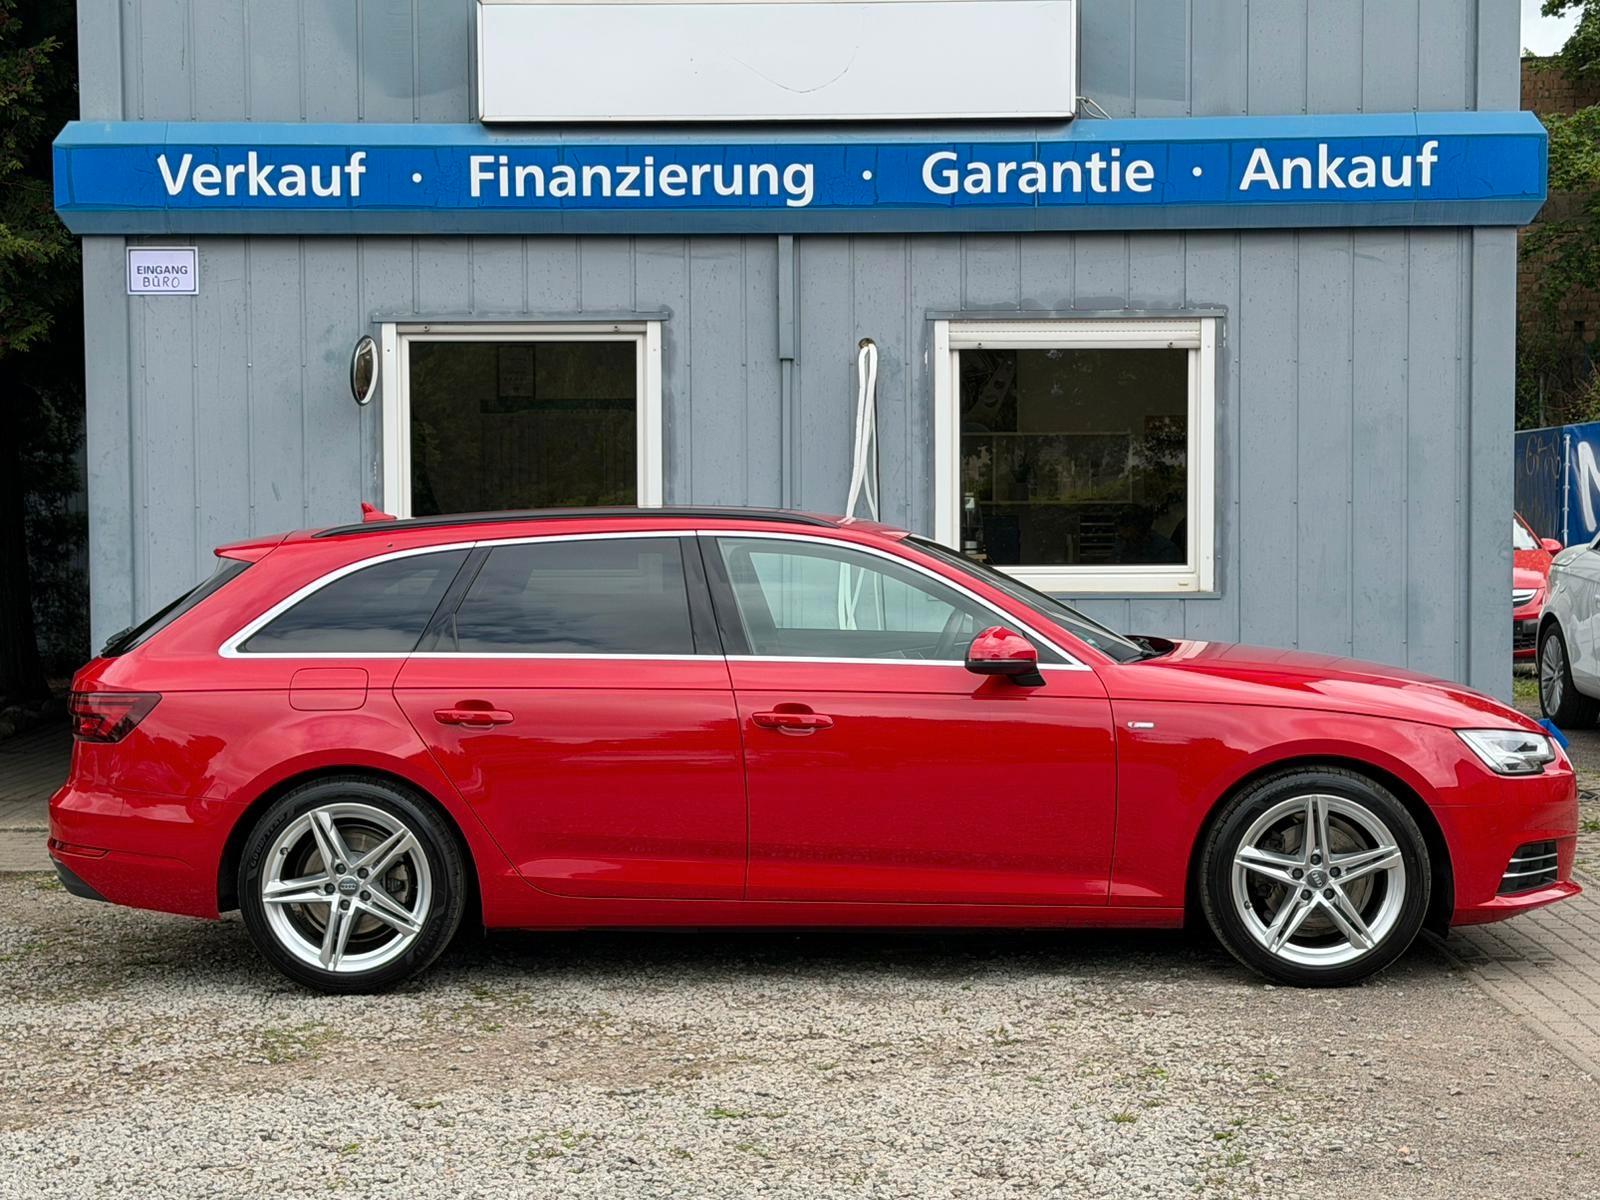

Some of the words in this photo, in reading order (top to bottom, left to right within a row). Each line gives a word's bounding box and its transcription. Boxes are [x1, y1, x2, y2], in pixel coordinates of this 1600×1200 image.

[156, 151, 366, 197] Verkauf
[470, 155, 814, 207] Finanzierung
[922, 147, 1155, 195] Garantie
[1239, 140, 1439, 191] Ankauf
[136, 265, 188, 275] EINGANG
[142, 275, 180, 288] BÜRO
